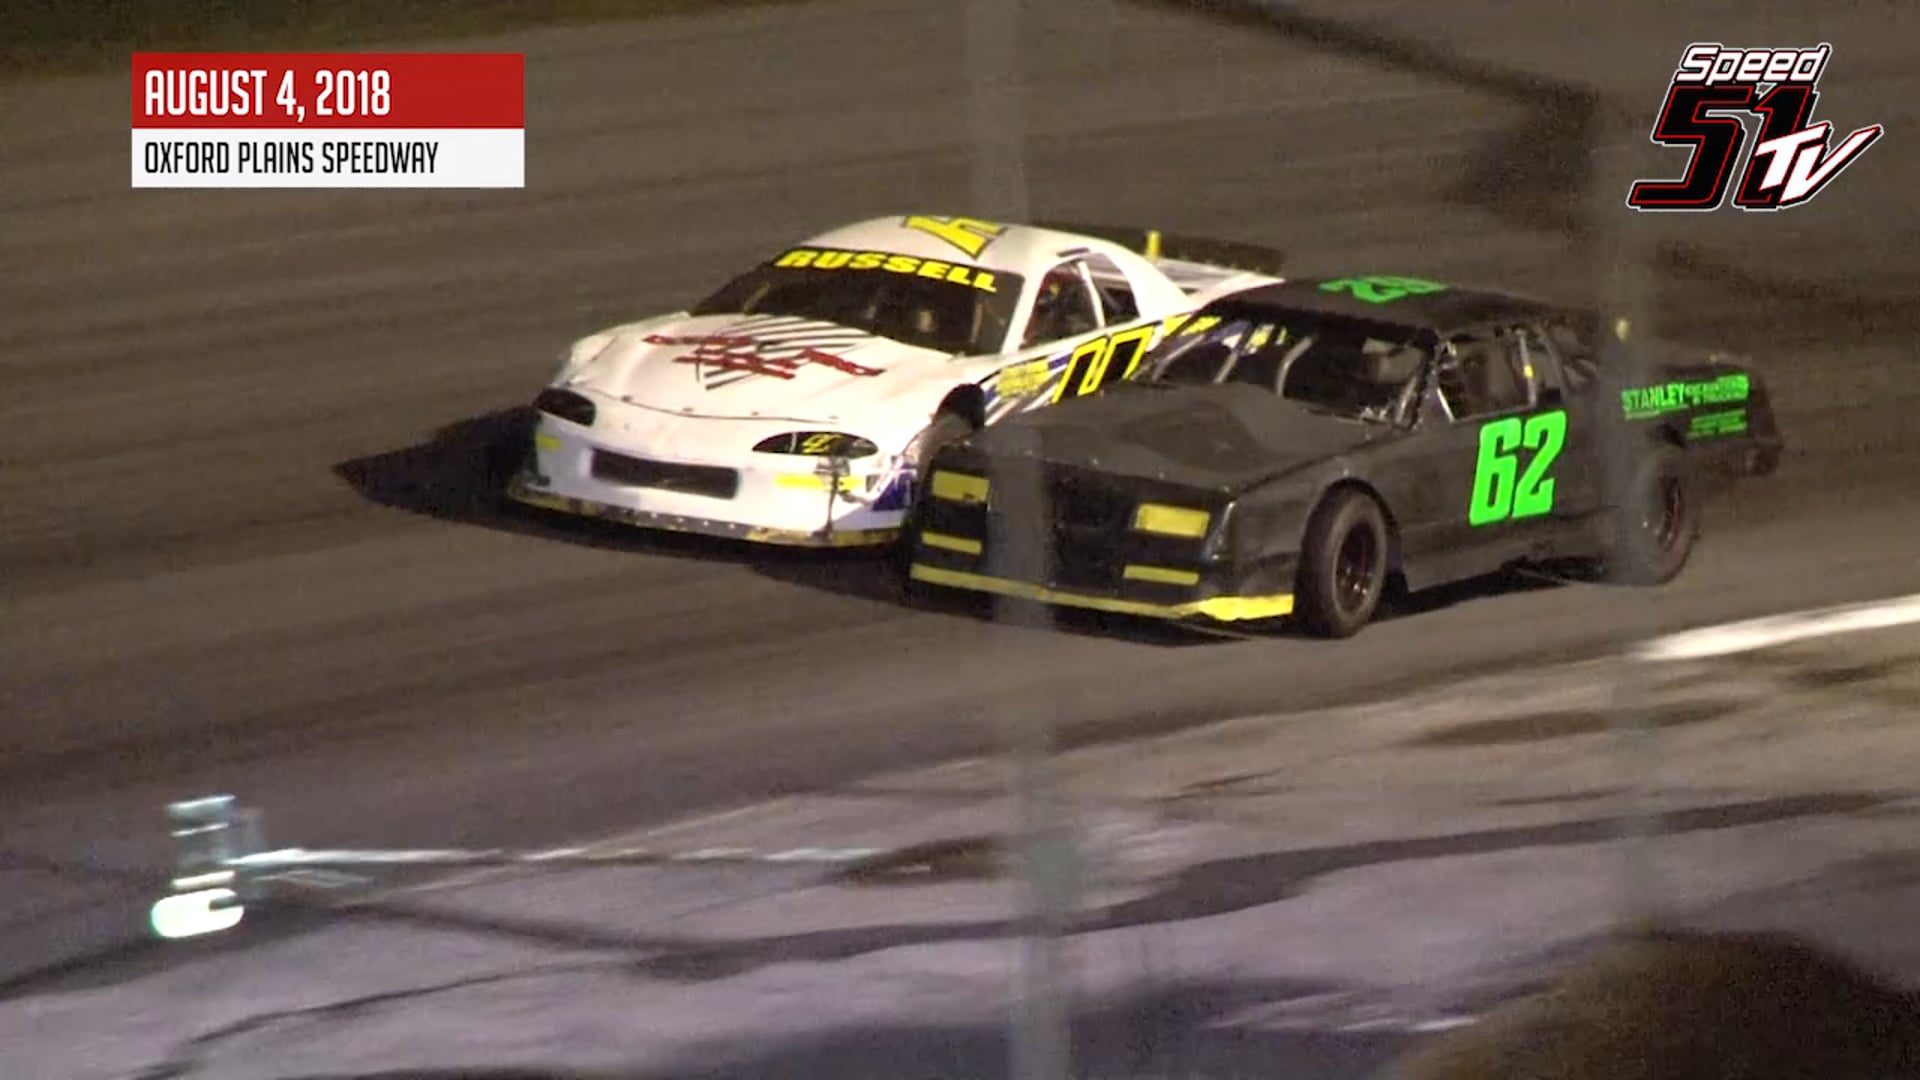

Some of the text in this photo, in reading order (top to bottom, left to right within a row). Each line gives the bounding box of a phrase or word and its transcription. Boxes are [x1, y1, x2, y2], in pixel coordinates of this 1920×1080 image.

[773, 250, 997, 292] RUSSELL
[1622, 383, 1685, 412] STANLEY
[1469, 409, 1567, 526] 62
